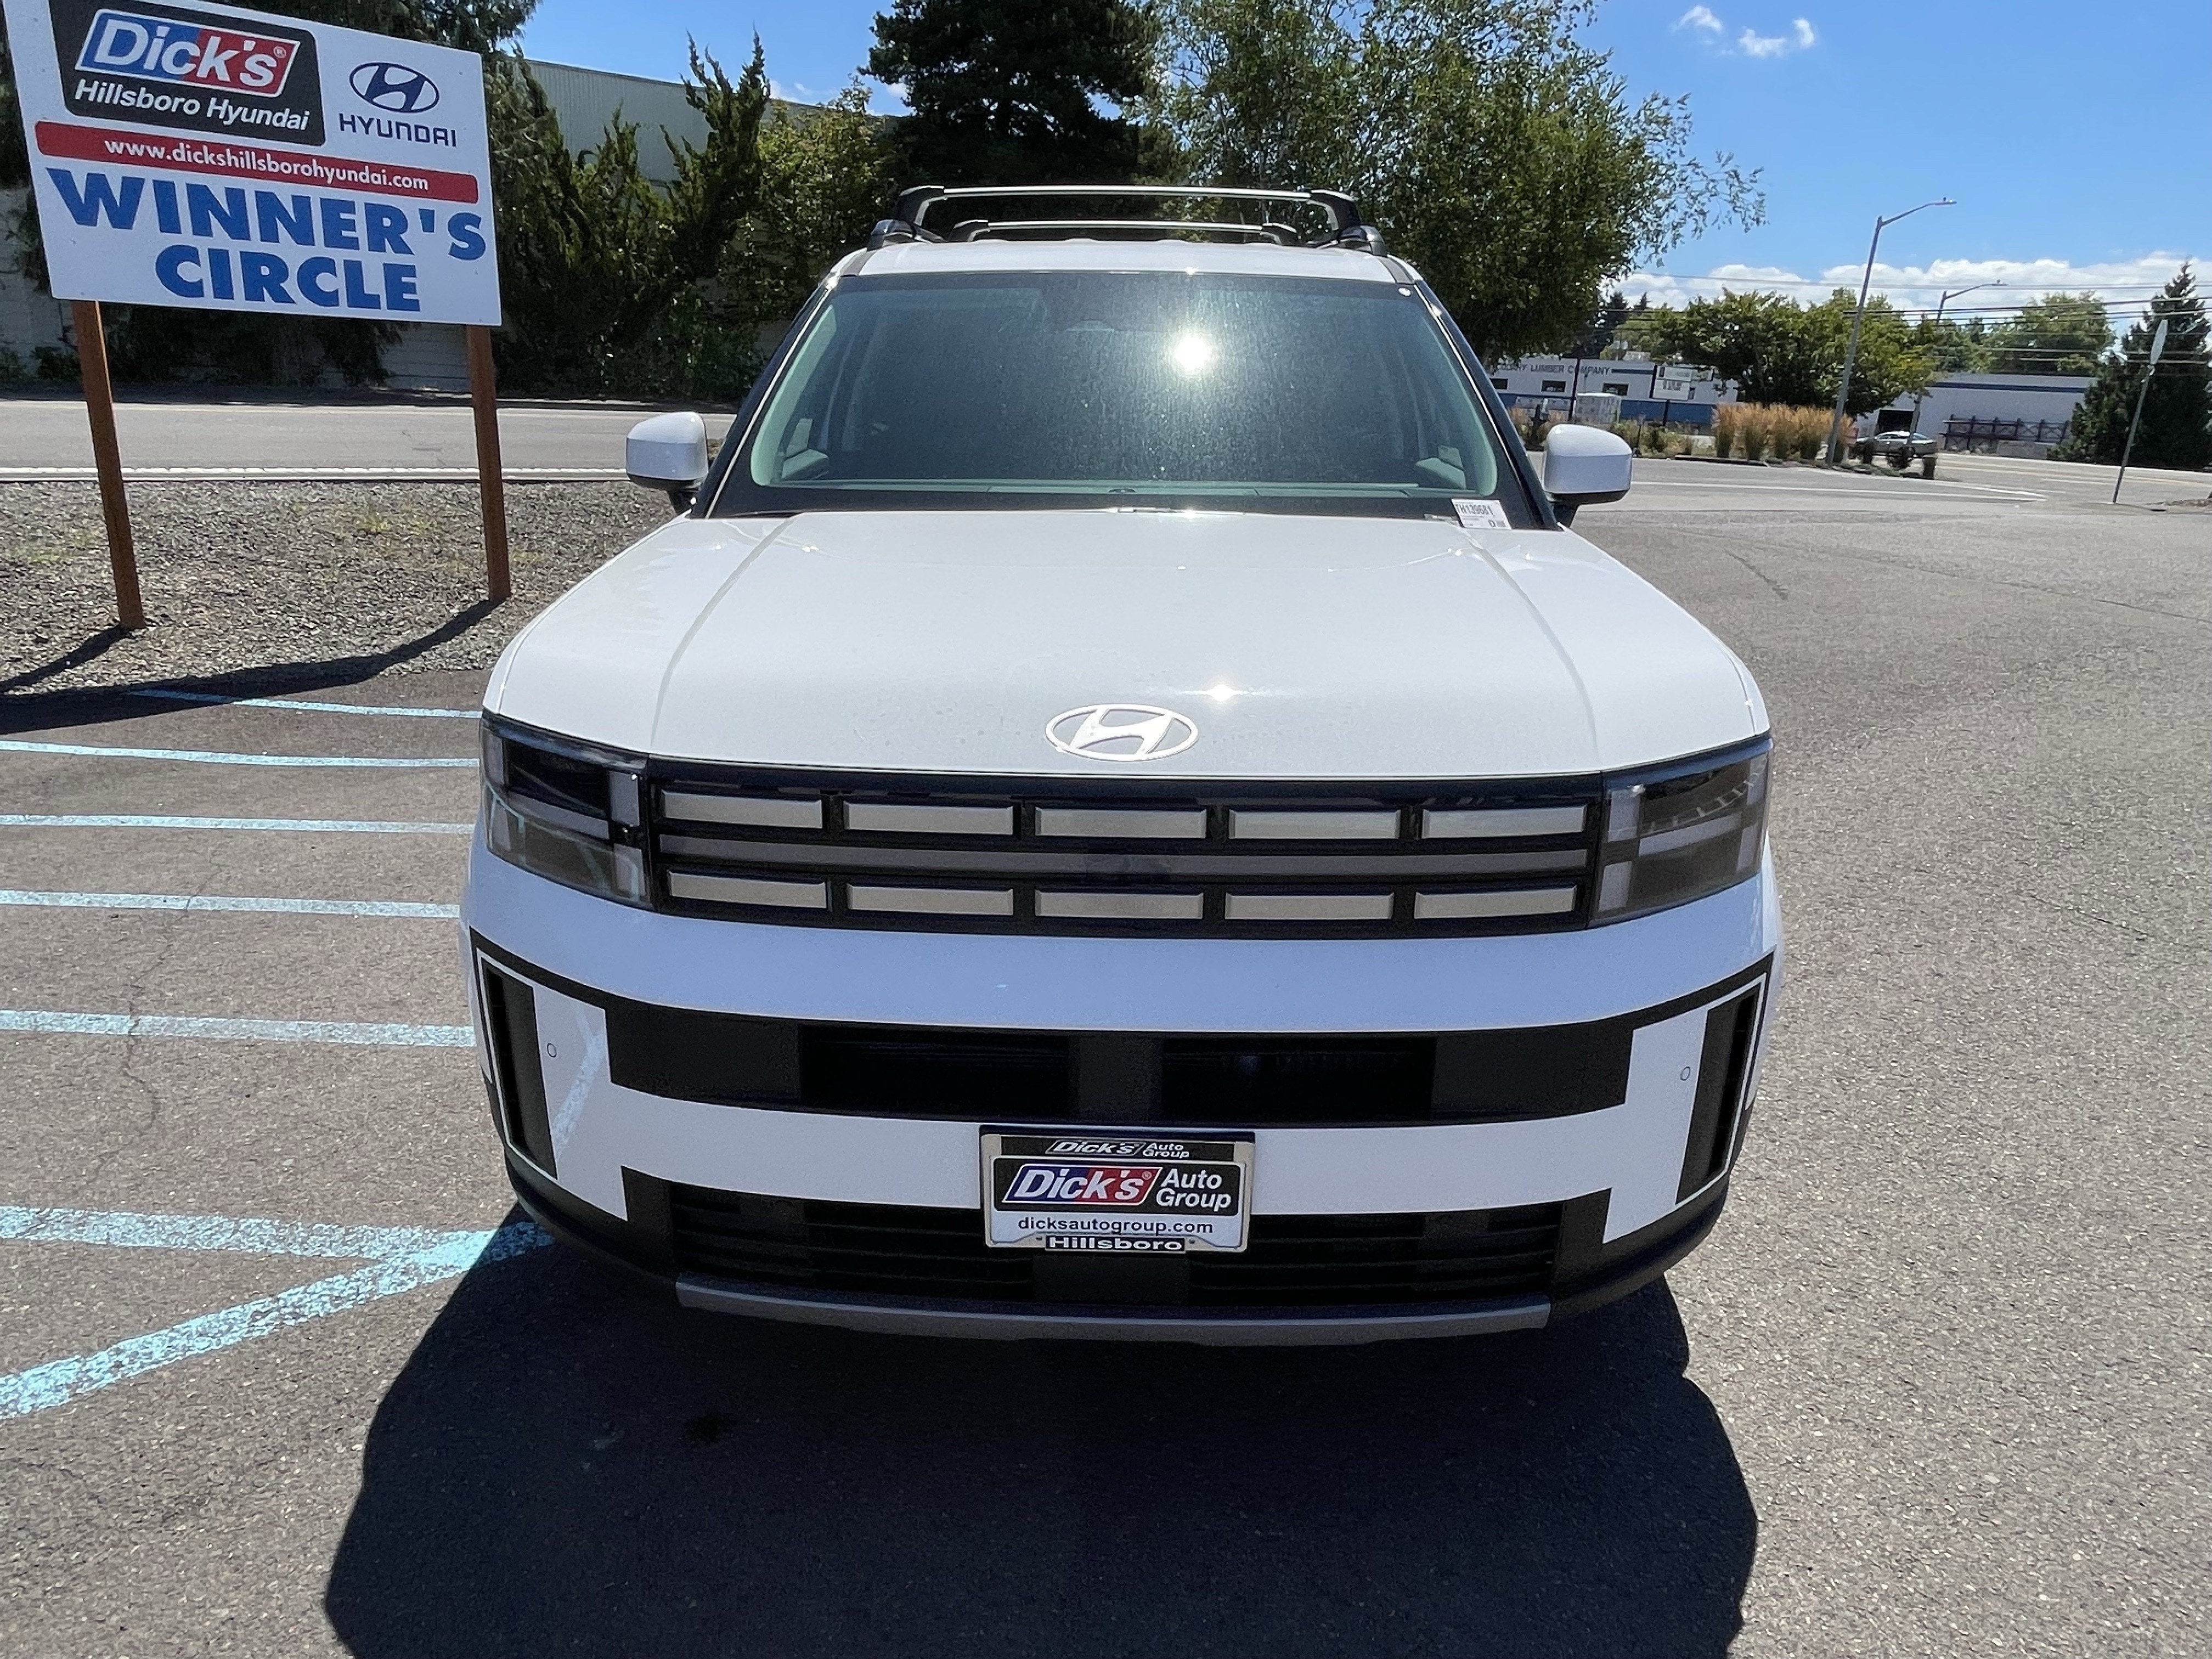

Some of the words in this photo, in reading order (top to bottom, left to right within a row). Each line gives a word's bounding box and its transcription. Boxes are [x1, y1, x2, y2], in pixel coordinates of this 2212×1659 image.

[93, 18, 278, 87] Dick's
[75, 79, 201, 115] Hillsboro
[207, 97, 311, 131] Hyundai
[338, 112, 456, 147] HYUNDAI
[104, 139, 430, 191] www.dickshillsborohyundai.com
[46, 167, 488, 261] WINNER'S
[155, 244, 421, 312] CIRCLE
[1531, 364, 1565, 373] LUMBER
[1567, 364, 1610, 375] CMPANY
[1053, 1141, 1135, 1154] Dick's
[1147, 1142, 1184, 1150] Auto
[1142, 1149, 1189, 1158] Group
[1014, 1169, 1144, 1200] Dick's
[1160, 1169, 1222, 1189] Auto
[1155, 1187, 1232, 1211] Group
[1018, 1217, 1213, 1234] dicksautogroup.com
[1049, 1237, 1183, 1250] Hillsboro
